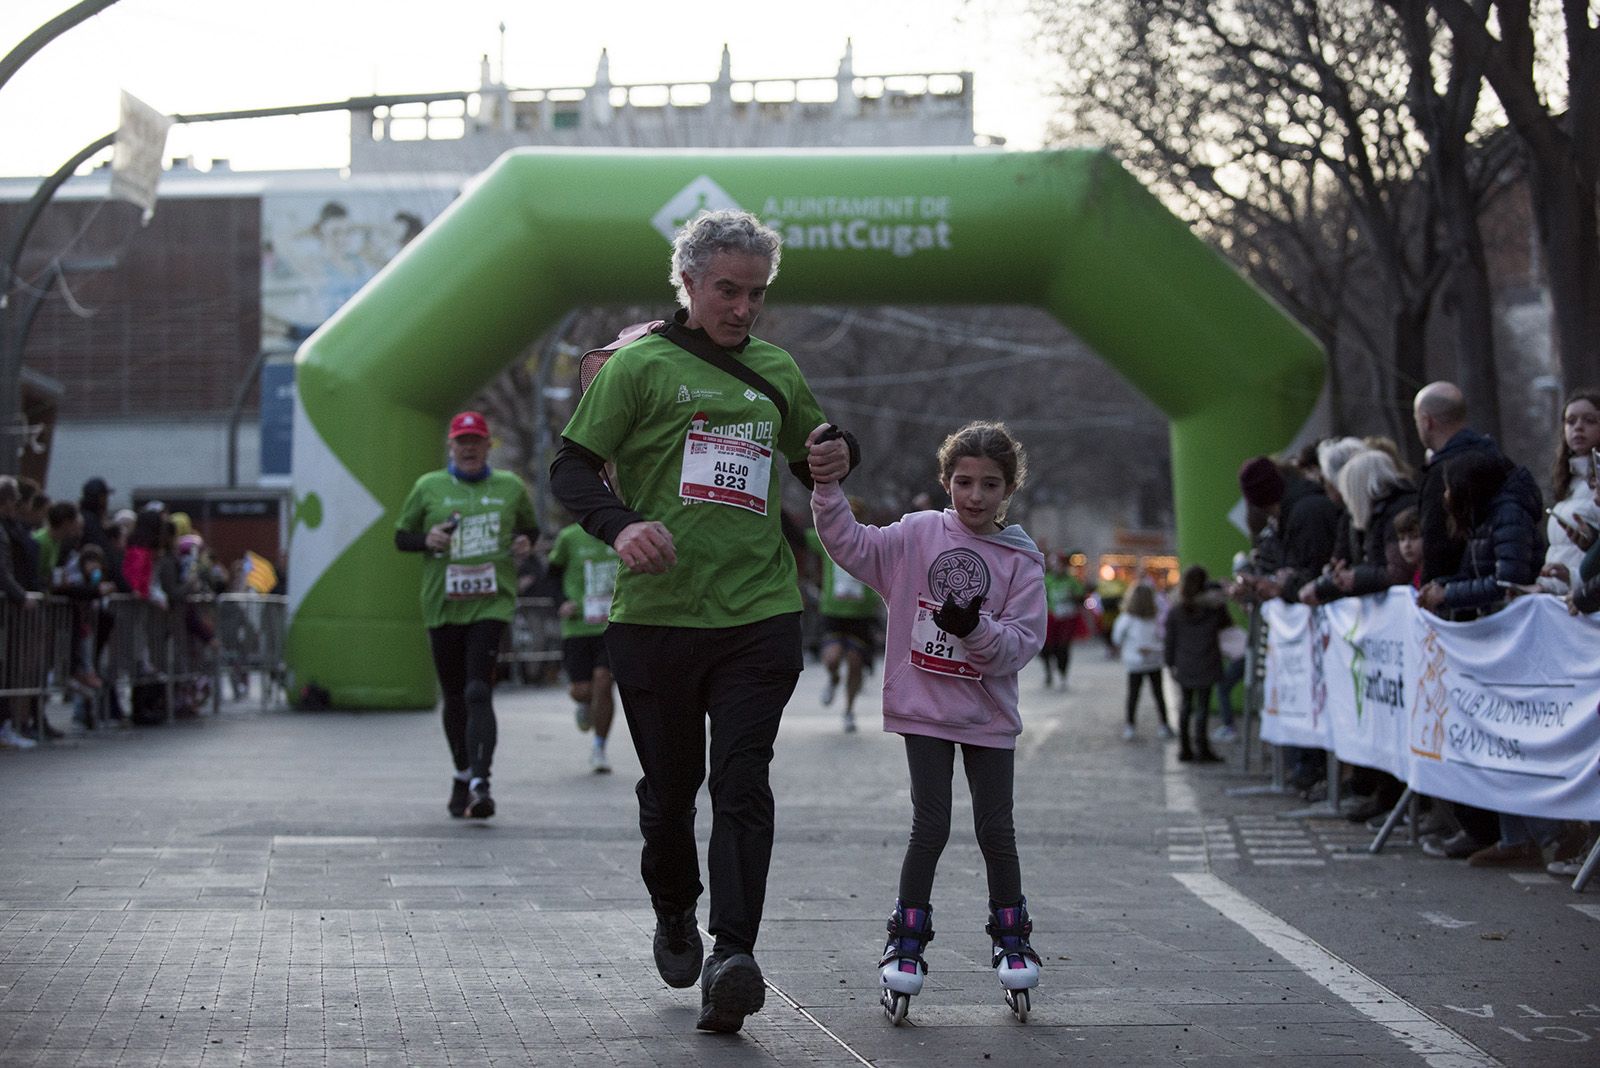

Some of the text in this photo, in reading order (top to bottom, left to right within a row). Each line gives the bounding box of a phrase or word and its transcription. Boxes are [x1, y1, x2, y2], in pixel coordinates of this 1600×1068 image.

[763, 196, 949, 218] AJUNTAMENT DE
[756, 421, 773, 440] DEL
[714, 461, 748, 477] ALEJO
[714, 473, 746, 491] 823
[936, 630, 948, 643] IA
[925, 641, 954, 659] 821
[1450, 687, 1485, 718] CLUB
